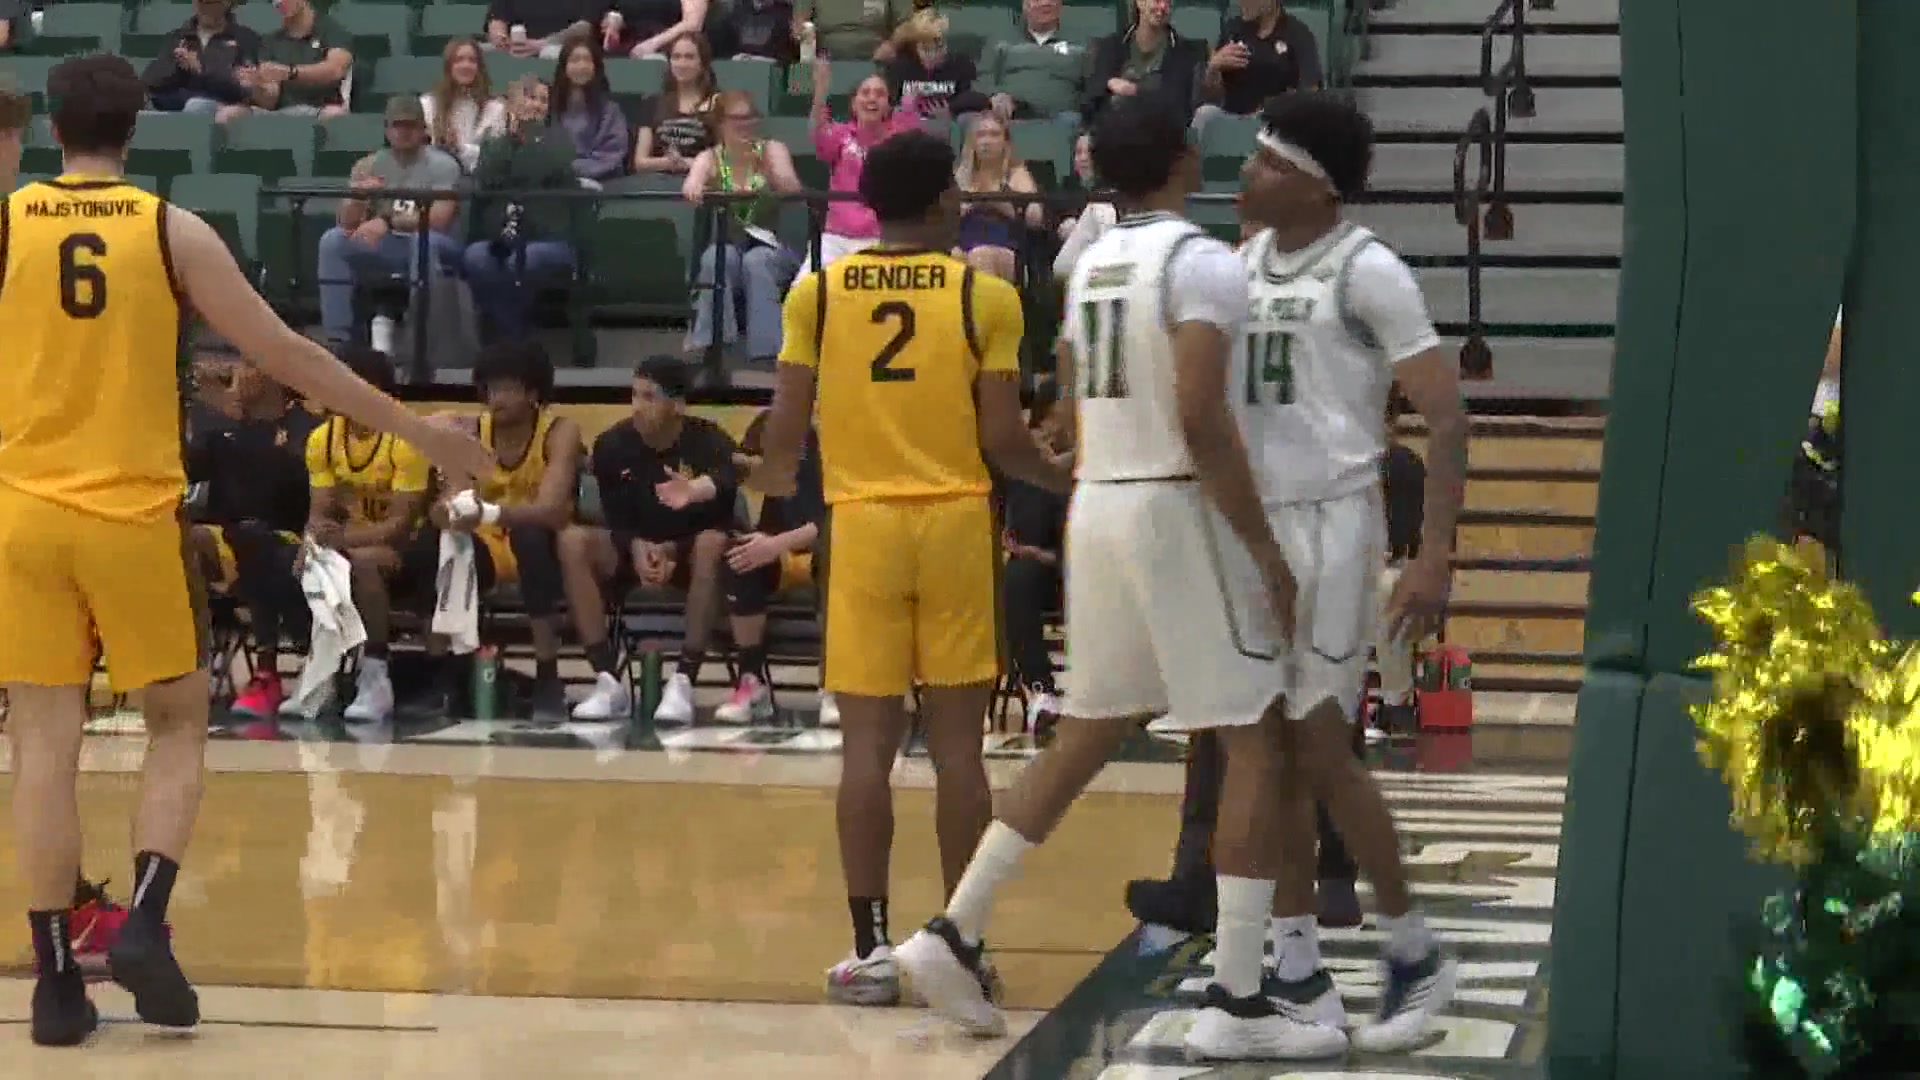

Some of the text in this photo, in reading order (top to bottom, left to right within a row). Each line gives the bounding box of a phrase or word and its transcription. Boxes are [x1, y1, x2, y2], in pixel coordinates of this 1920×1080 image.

[59, 232, 107, 319] 6
[844, 264, 946, 290] BENDER
[870, 301, 916, 382] 2
[1082, 299, 1129, 398] 11
[1246, 332, 1297, 404] 14
